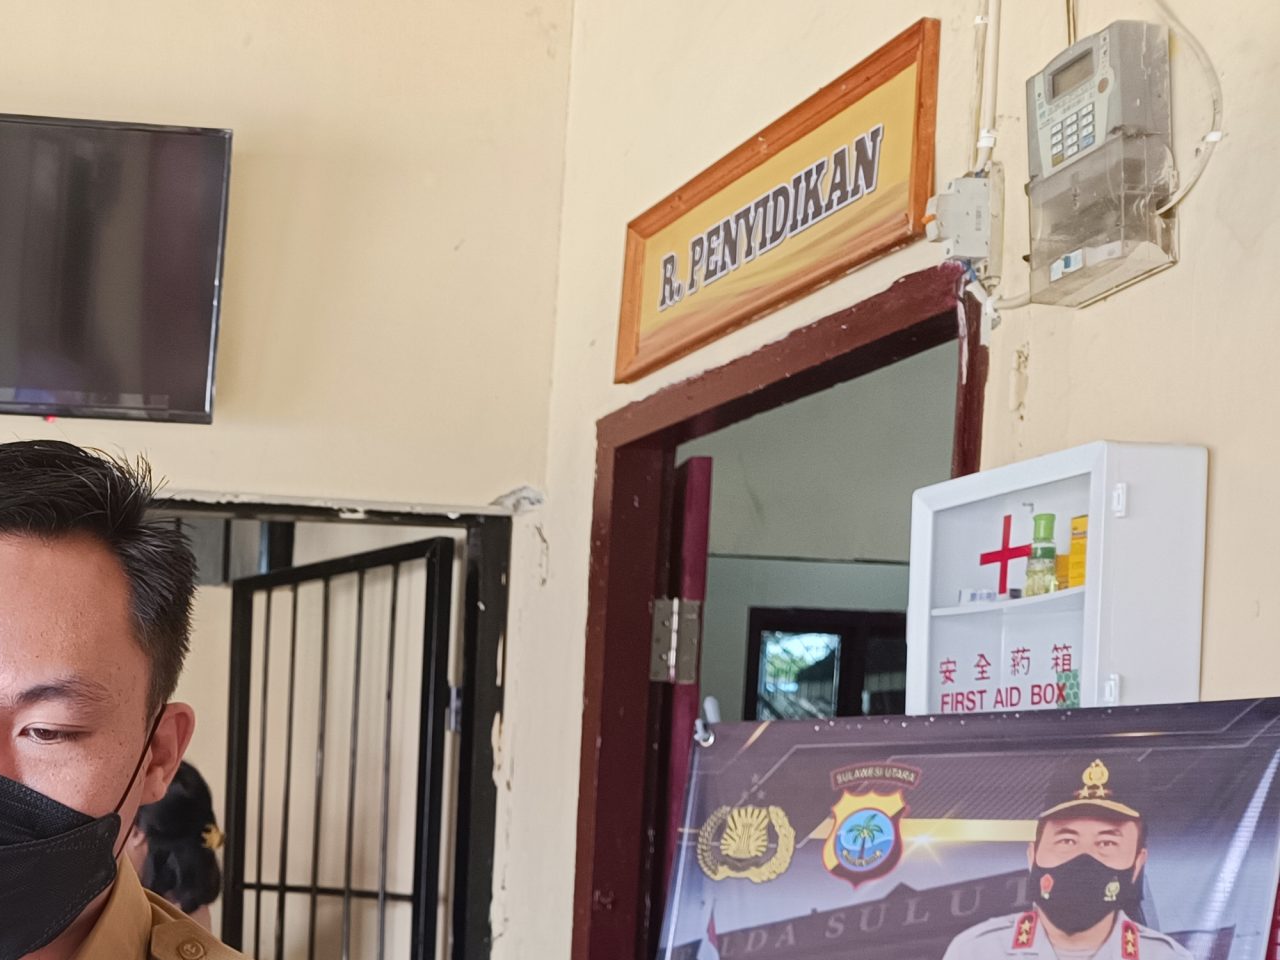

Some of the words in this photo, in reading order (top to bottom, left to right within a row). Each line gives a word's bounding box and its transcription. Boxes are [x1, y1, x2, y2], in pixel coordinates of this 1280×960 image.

[659, 253, 683, 309] R.
[687, 124, 882, 294] PENYIDIKAN
[940, 690, 987, 713] FIRST
[993, 687, 1022, 709] AID
[1031, 682, 1067, 705] BOX
[836, 767, 882, 784] SULAWESI
[884, 767, 915, 783] UTARA
